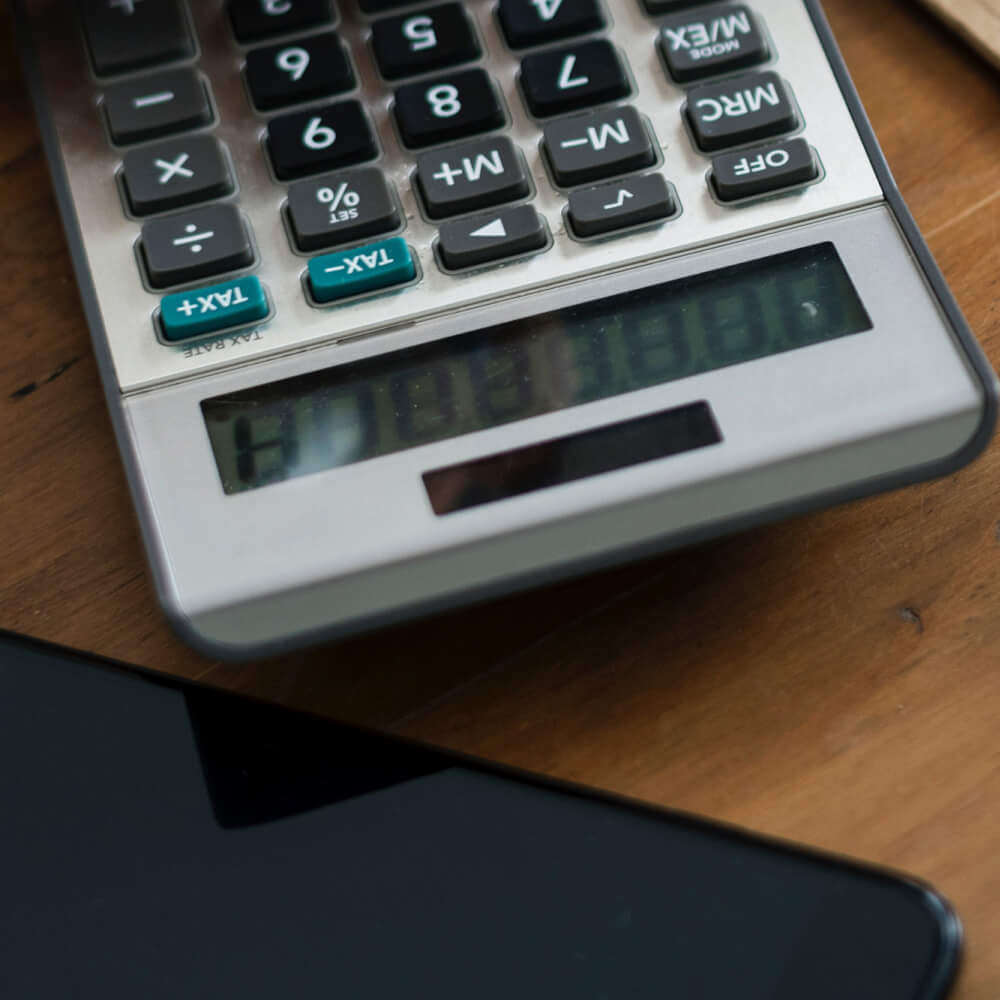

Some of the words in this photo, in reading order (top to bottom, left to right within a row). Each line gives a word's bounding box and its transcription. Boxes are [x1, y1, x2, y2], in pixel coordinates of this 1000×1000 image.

[403, 16, 438, 51] 5
[665, 11, 751, 51] M/EX
[276, 48, 310, 81] 6
[690, 39, 740, 60] MODE
[558, 55, 589, 89] 7
[426, 84, 462, 117] 8
[696, 83, 781, 122] MRC
[303, 116, 336, 150] 9
[433, 149, 505, 187] M+
[733, 149, 790, 176] OFF
[317, 182, 360, 212] %
[329, 208, 359, 224] SET
[177, 286, 248, 316] TAX+
[183, 335, 225, 358] RATE
[231, 330, 264, 345] TAX
